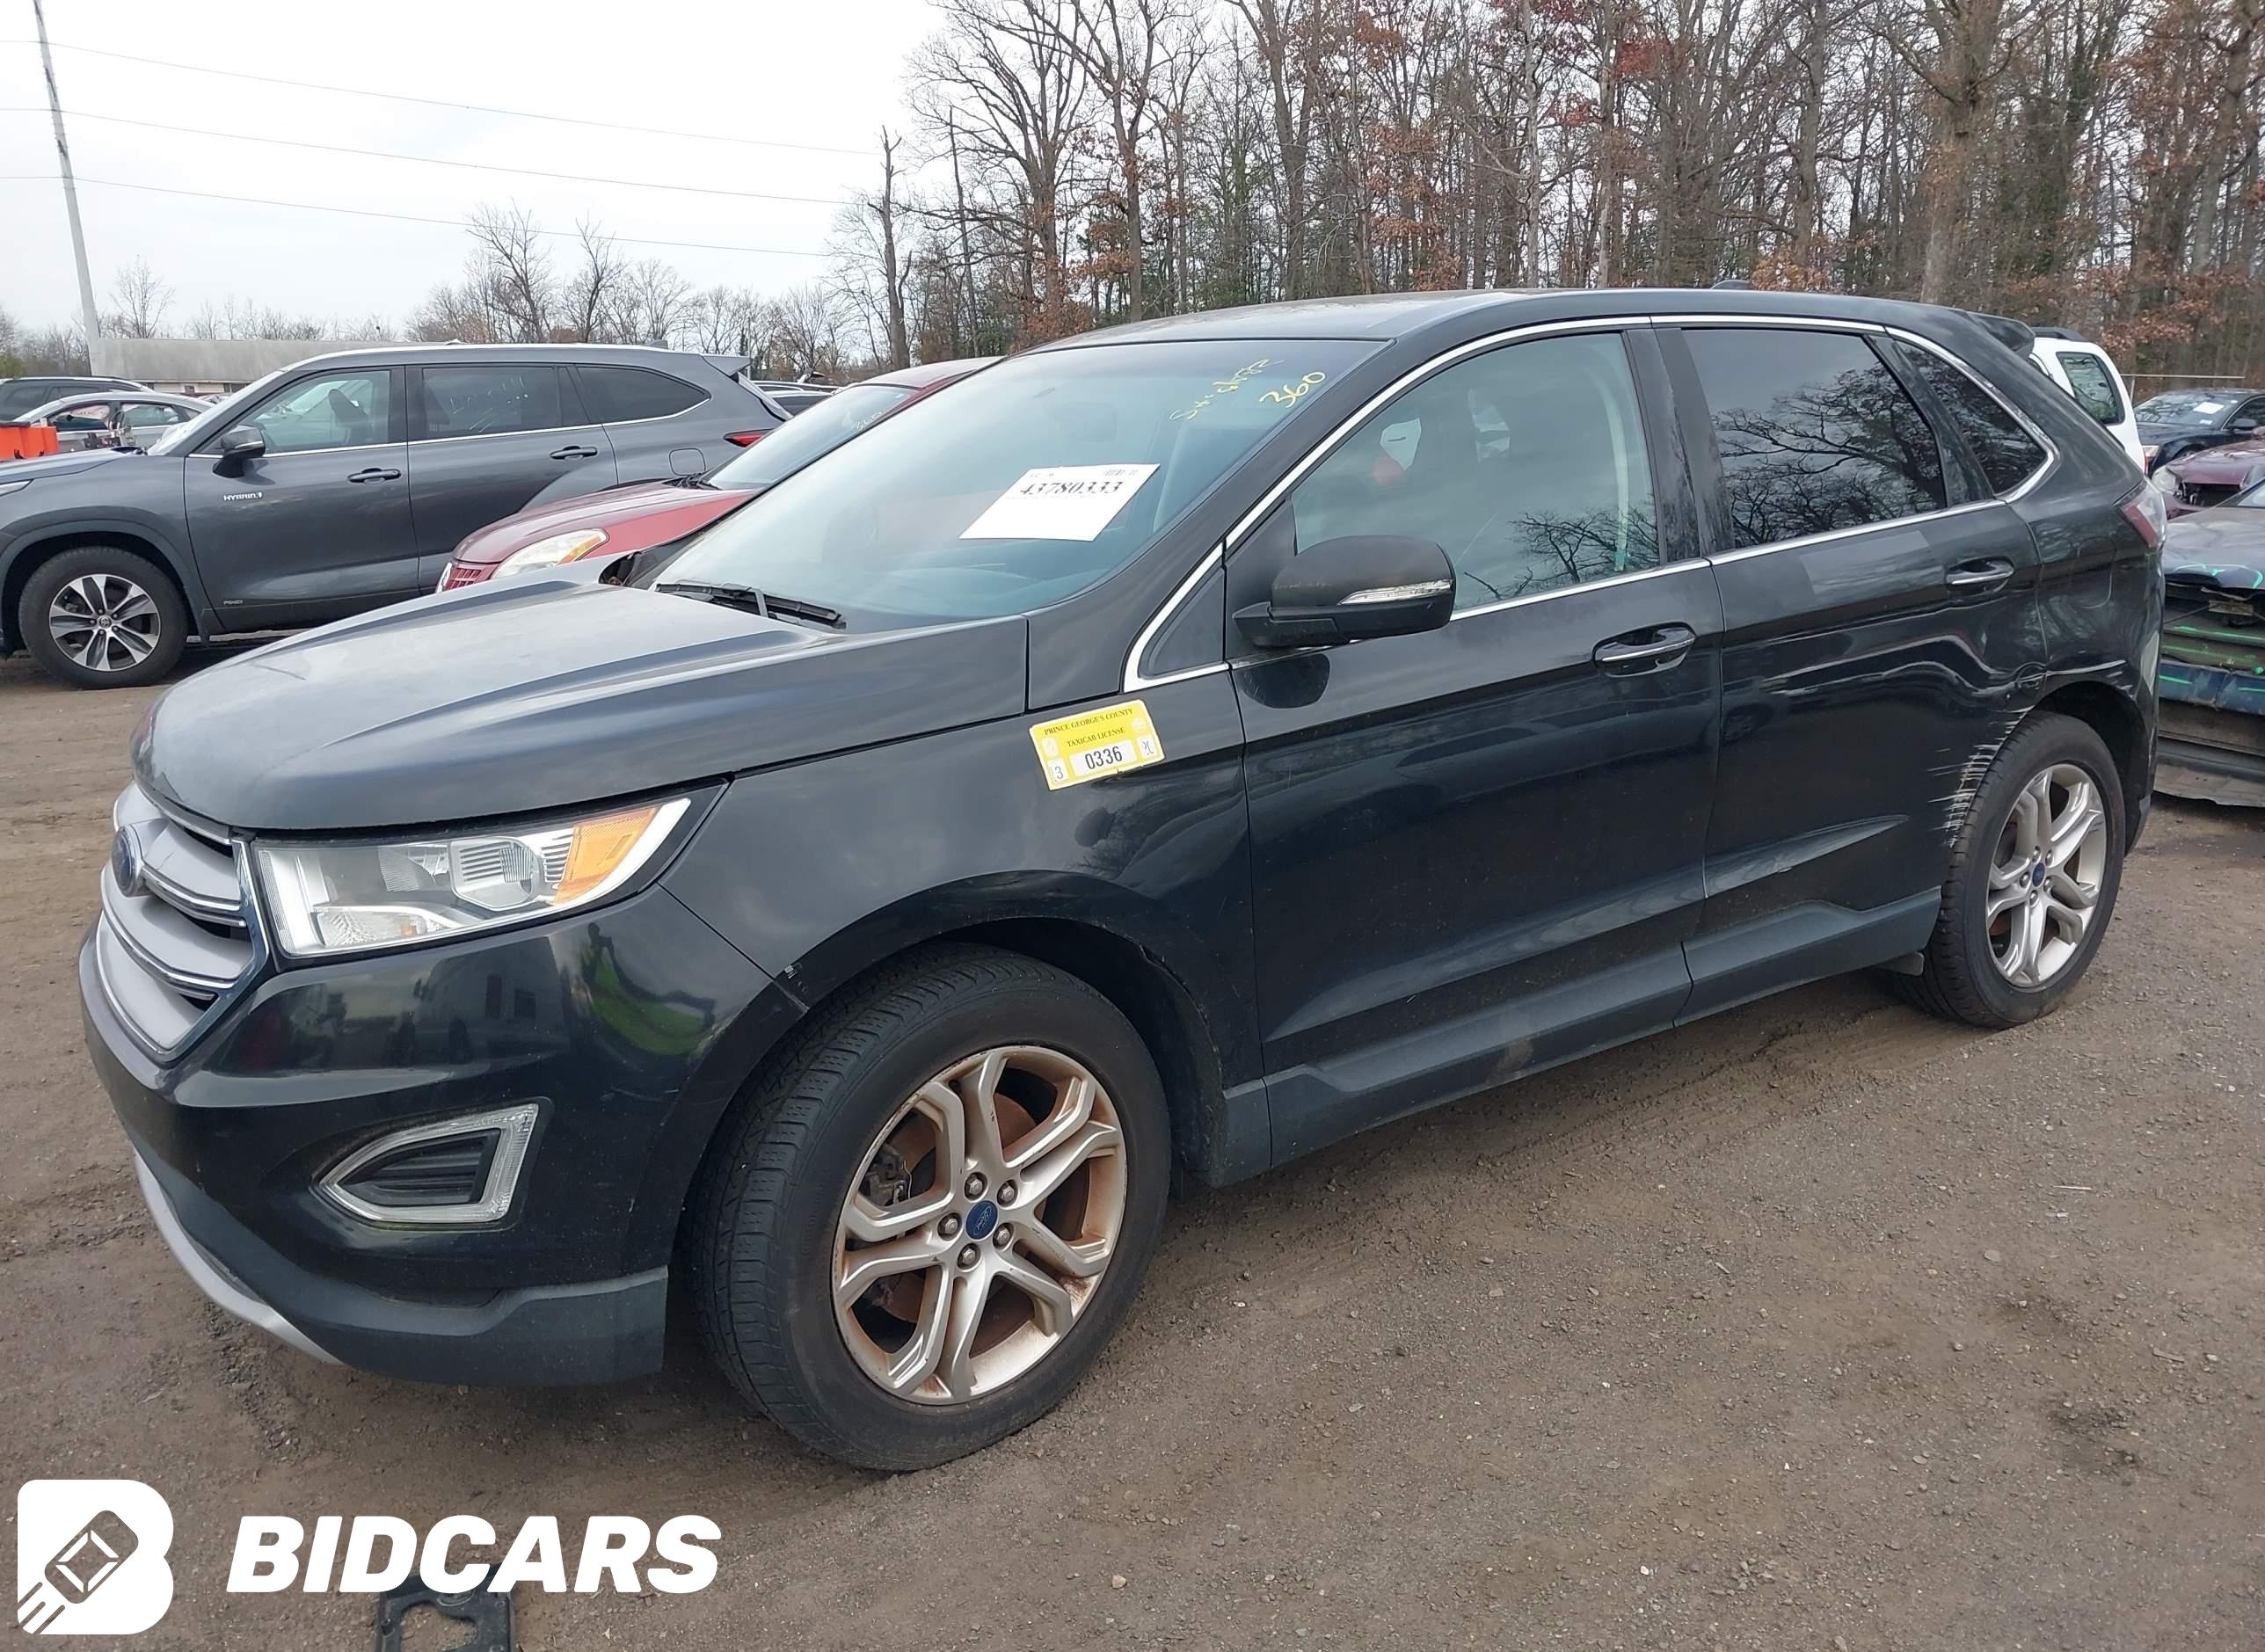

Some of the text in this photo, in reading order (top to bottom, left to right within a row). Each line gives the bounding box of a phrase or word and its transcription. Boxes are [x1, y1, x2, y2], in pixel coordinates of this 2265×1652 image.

[1258, 371, 1326, 409] 360
[223, 492, 257, 501] HYBRID
[1020, 481, 1124, 495] 43780333
[1044, 708, 1134, 736] PRINCE GEORGE'S COUNTY
[1067, 727, 1126, 747] TAXICAB LICENSE
[1084, 746, 1123, 769] 0336
